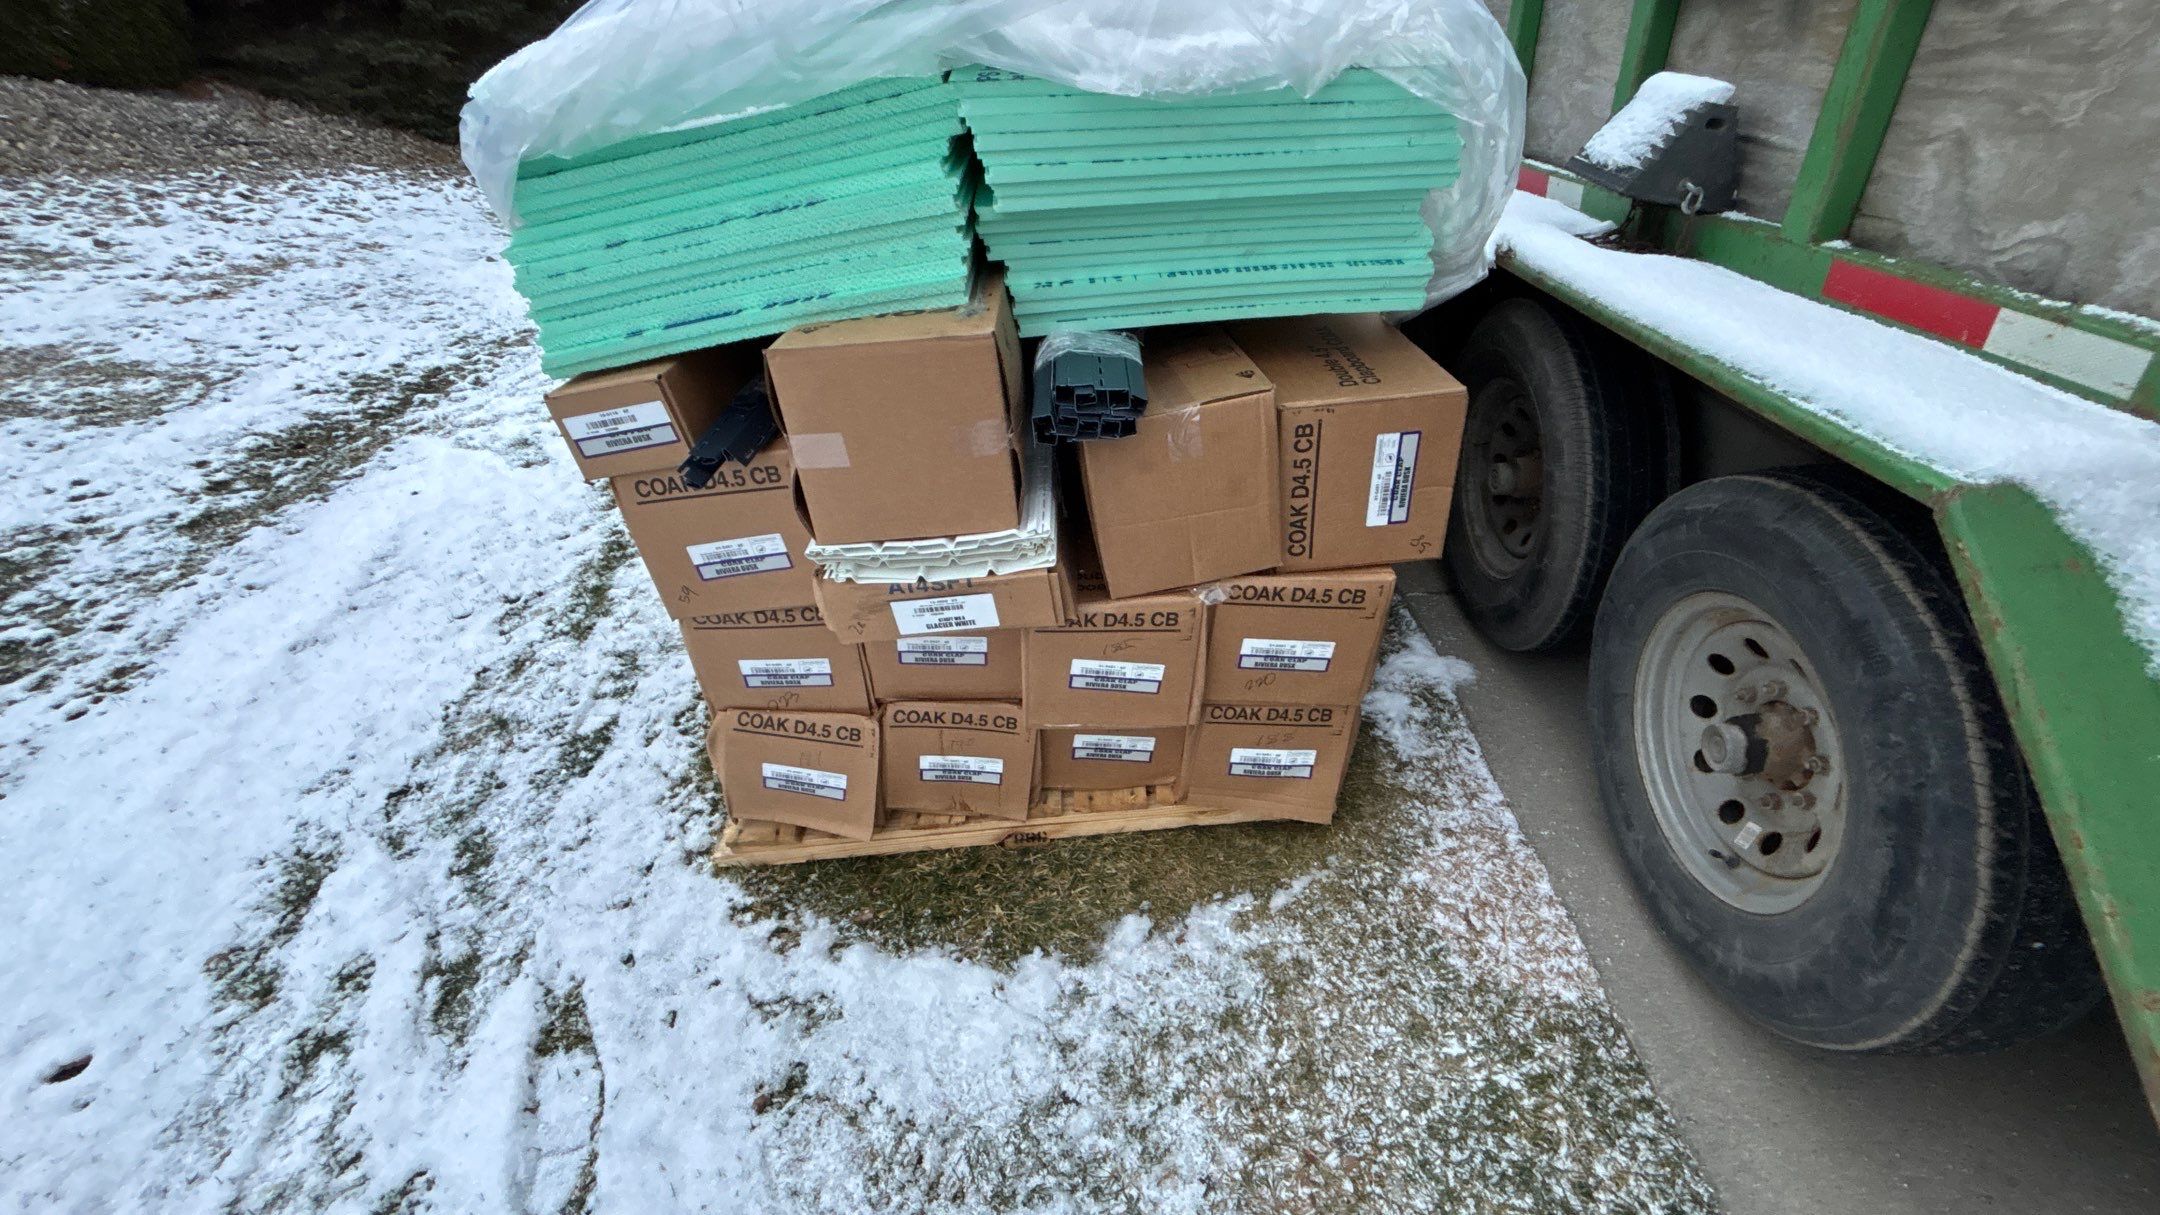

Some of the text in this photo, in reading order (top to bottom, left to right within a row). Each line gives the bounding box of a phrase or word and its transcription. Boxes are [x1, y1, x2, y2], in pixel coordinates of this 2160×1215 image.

[605, 434, 652, 448] RIVIERA DUSK
[1293, 423, 1314, 453] CB
[750, 465, 782, 485] CB
[1290, 458, 1312, 499] D4.5
[1398, 484, 1409, 508] RIVIERA
[1287, 503, 1309, 557] COAK
[715, 564, 759, 576] RIVIERA DUSK
[1229, 584, 1367, 605] COAK D4.5 CB
[753, 609, 796, 624] D4.5
[926, 620, 977, 630] GLACIER WHITE
[1103, 612, 1146, 627] D4.5
[1150, 611, 1179, 627] CB
[893, 709, 1018, 730] COAK D4.5 CB
[1210, 706, 1333, 722] COAK D4.5 CB
[737, 711, 862, 742] COAK D4.5 CB
